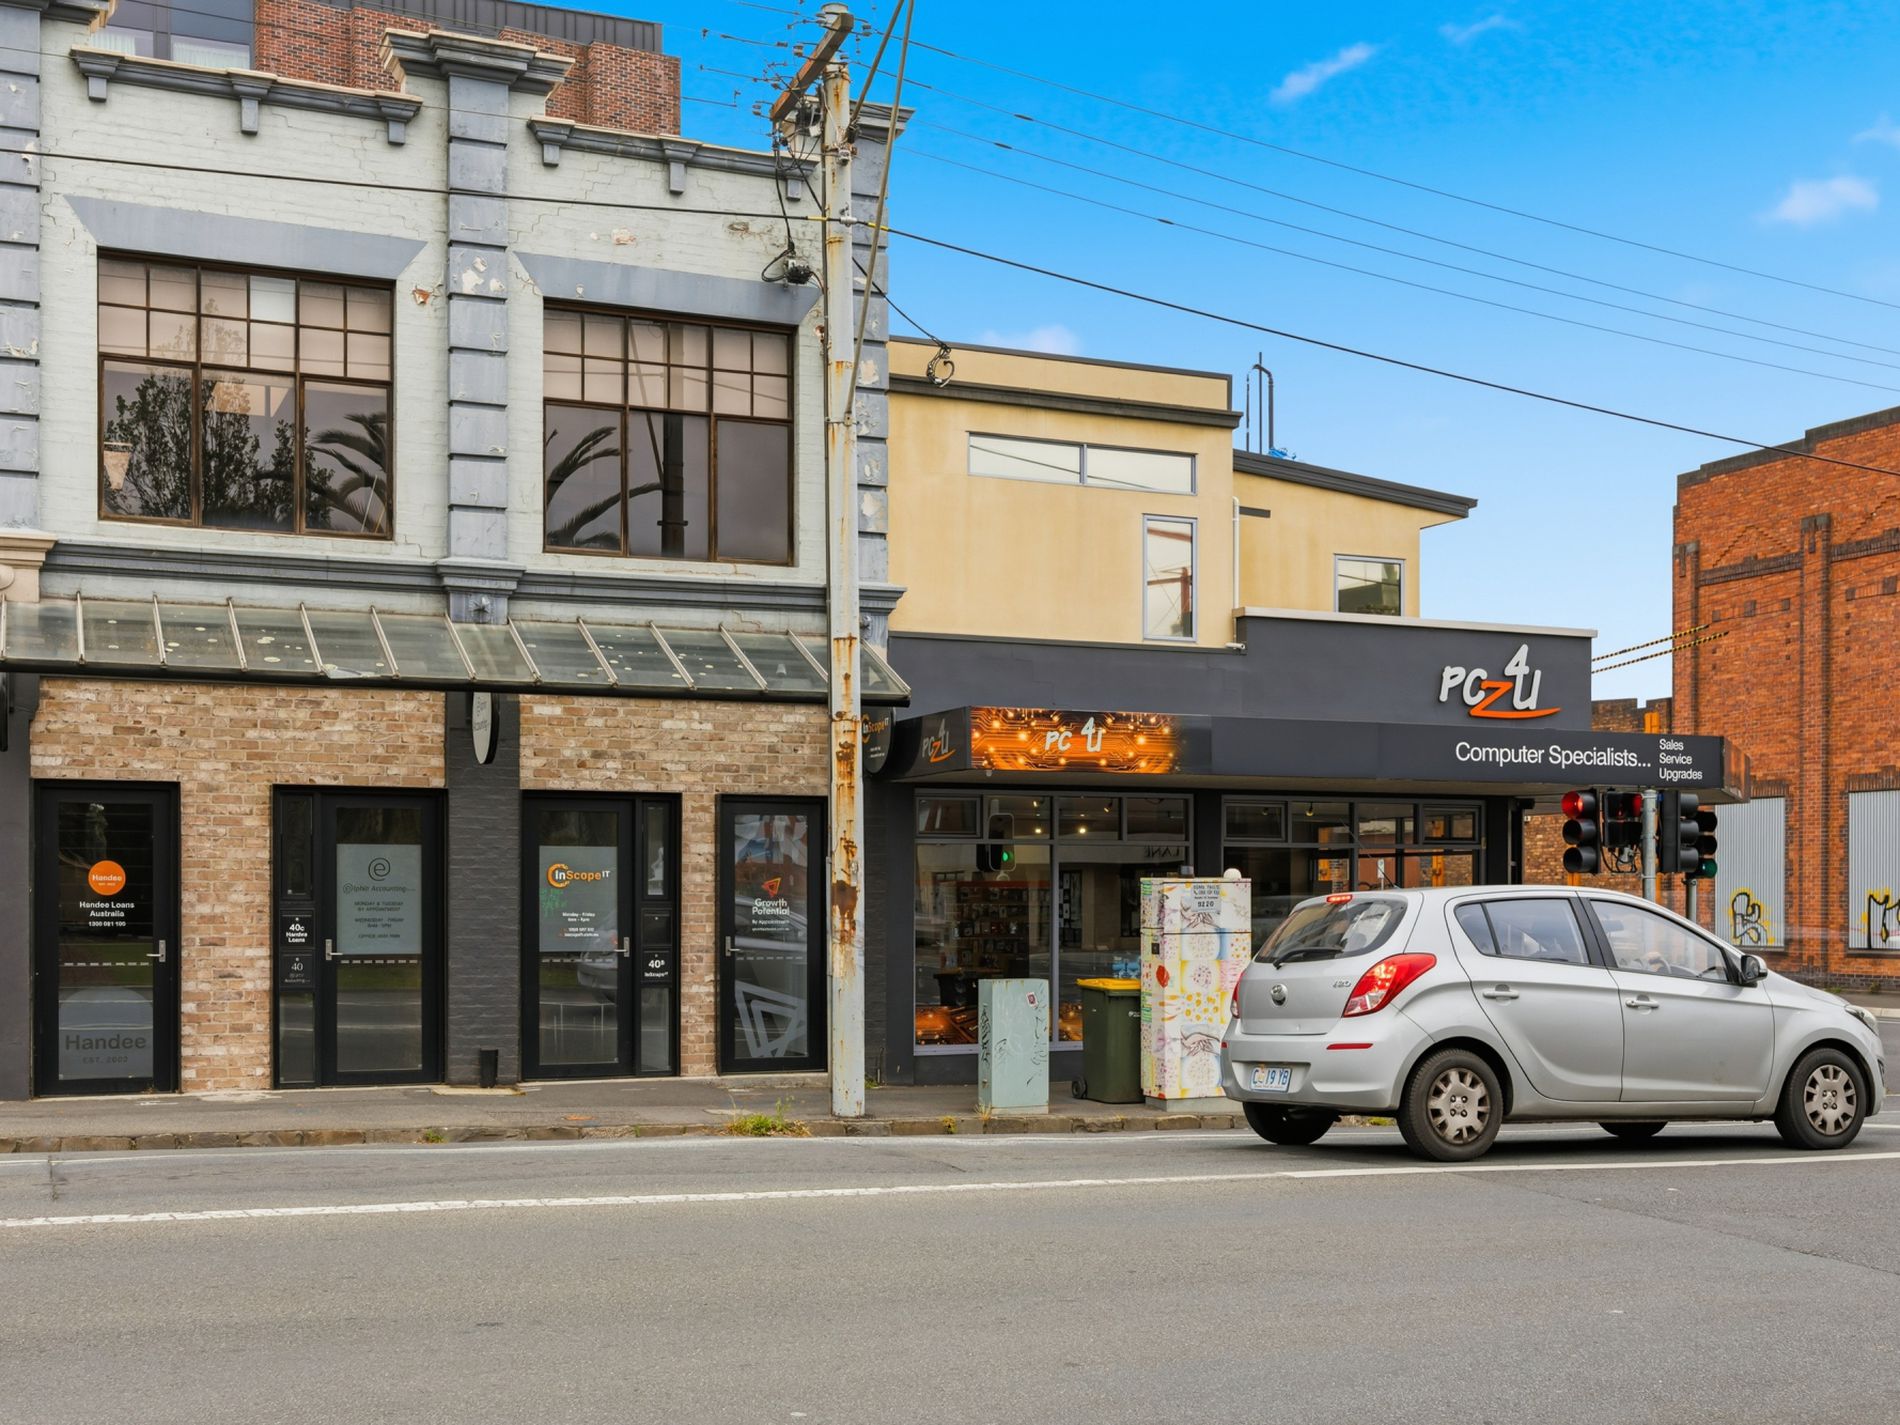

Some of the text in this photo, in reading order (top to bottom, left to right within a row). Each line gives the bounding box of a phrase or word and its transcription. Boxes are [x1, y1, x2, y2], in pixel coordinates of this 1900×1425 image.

[1659, 738, 1684, 751] Sales
[1455, 741, 1545, 767] Computer
[1659, 752, 1692, 765] Service
[1659, 768, 1703, 782] Upgrades
[79, 901, 135, 909] Handee Loans
[755, 898, 788, 907] Growth
[752, 906, 790, 915] Potential
[291, 962, 304, 971] 40
[65, 1033, 146, 1051] Handee
